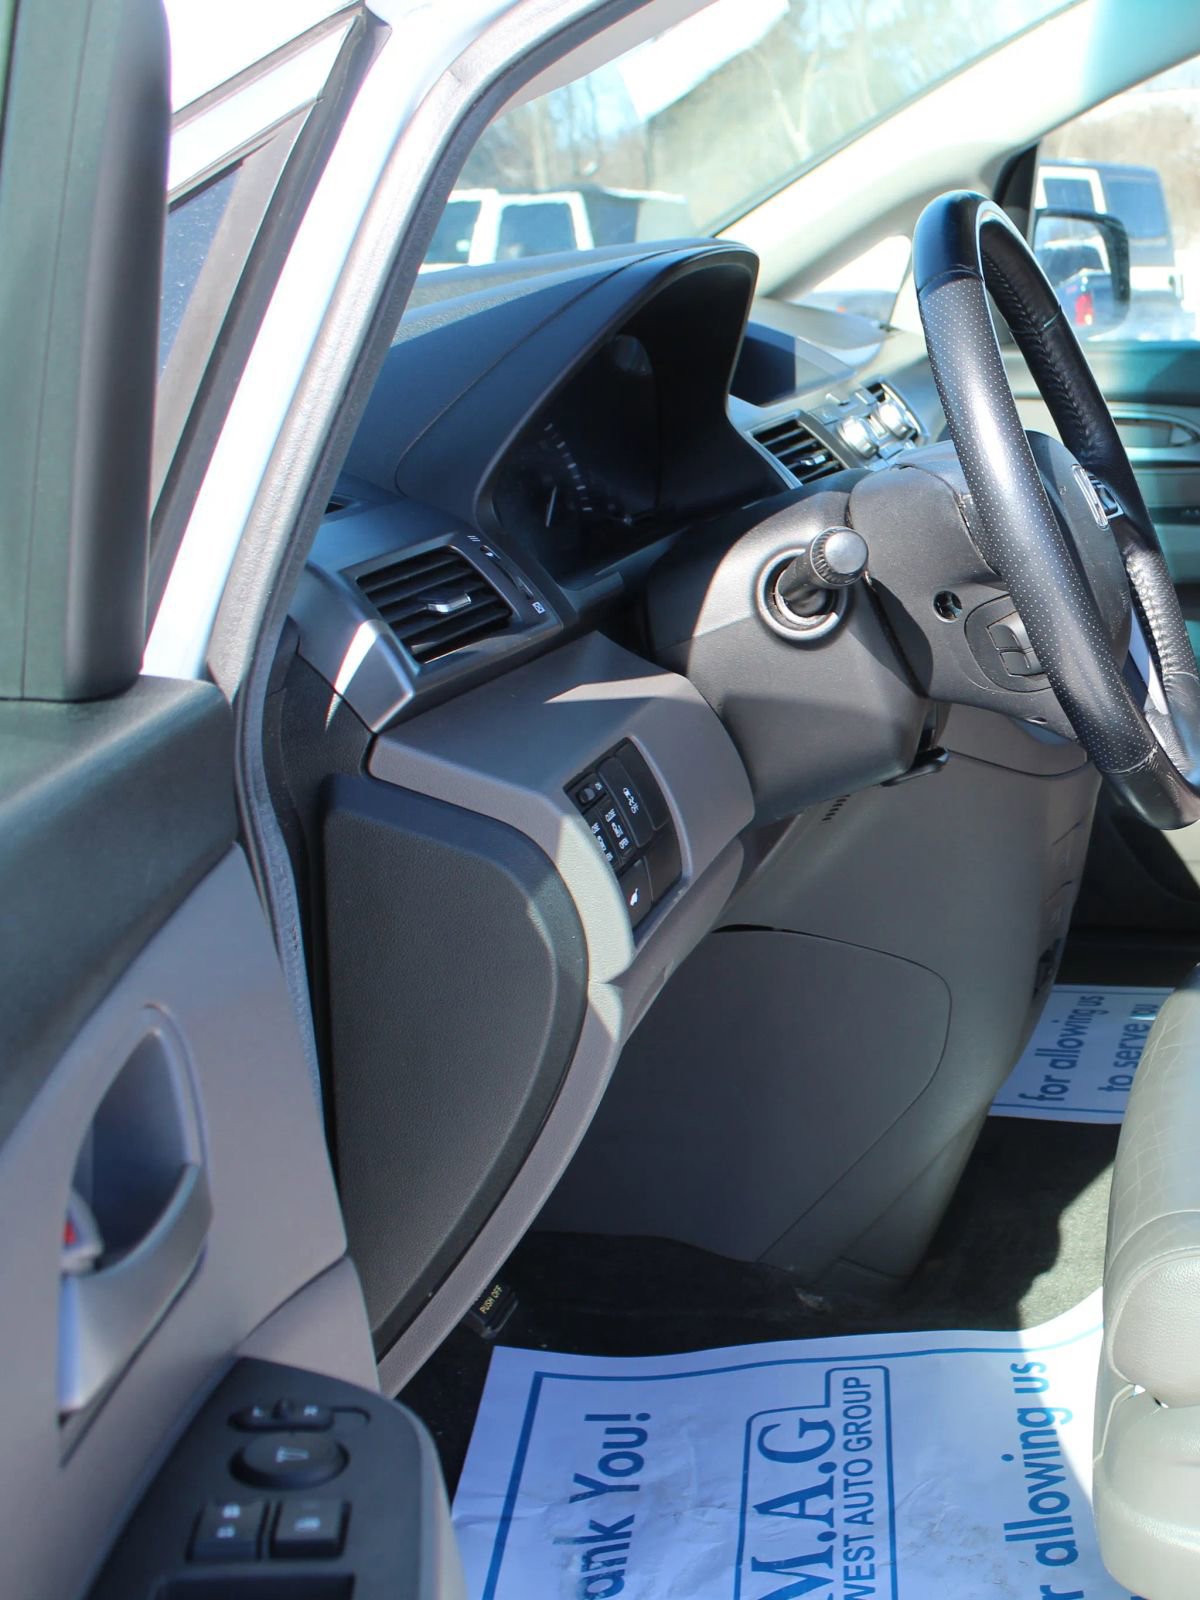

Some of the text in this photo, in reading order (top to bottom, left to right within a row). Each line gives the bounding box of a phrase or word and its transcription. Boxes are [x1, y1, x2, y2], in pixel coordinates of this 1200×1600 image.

[1018, 995, 1110, 1101] for allowing us
[1113, 1023, 1151, 1069] serve
[1098, 1074, 1134, 1092] to
[1010, 1361, 1050, 1395] us
[842, 1376, 873, 1453] GROUP
[552, 1412, 652, 1600] ank You!
[843, 1458, 875, 1525] AUTO
[1001, 1406, 1080, 1567] allowing
